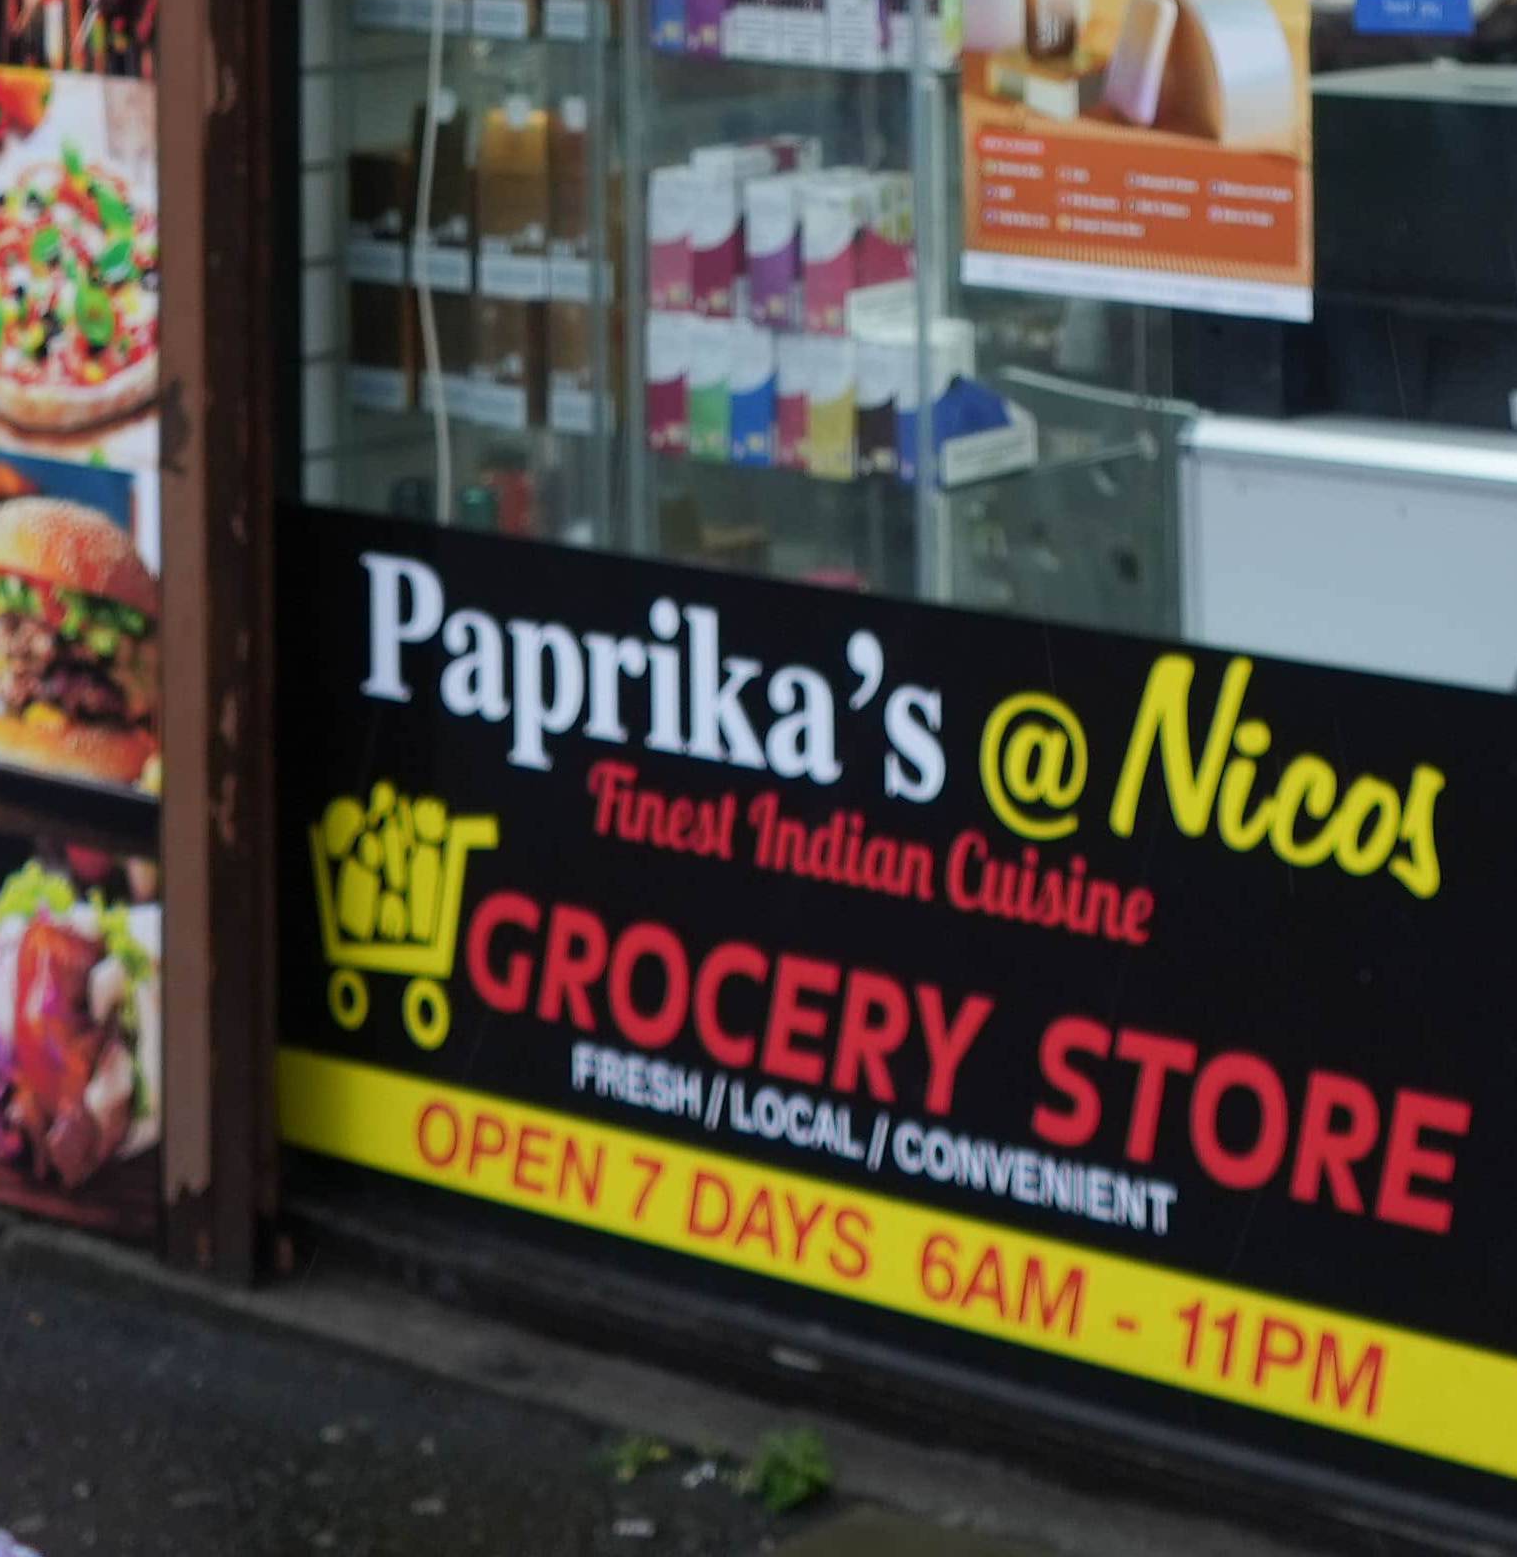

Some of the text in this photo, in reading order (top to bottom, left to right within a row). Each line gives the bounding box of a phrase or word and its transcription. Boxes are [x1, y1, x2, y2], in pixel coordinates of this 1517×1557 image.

[358, 551, 1444, 896] Paprika's @ Nicos
[591, 763, 1153, 942] Finest Indian Cuisine
[469, 890, 1470, 1231] GROCERY STORE
[573, 1045, 1176, 1231] FRESH / LOCAL / CONVENIENT
[415, 1099, 1384, 1418] OPEN 7 DAYS 6AM - 11PM
